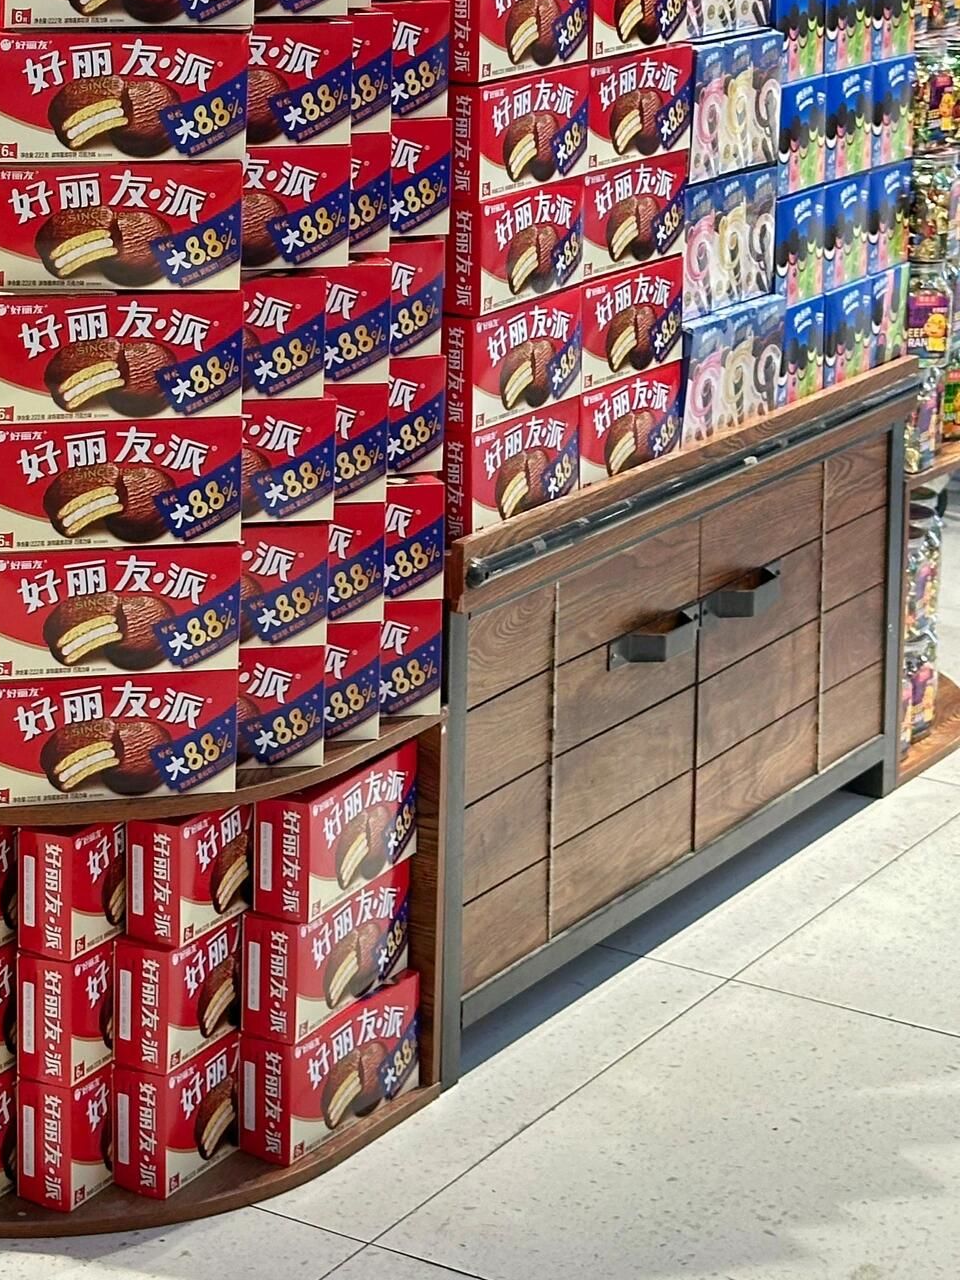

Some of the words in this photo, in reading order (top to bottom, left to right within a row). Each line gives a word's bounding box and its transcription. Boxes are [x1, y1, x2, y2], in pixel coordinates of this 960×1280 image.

[22, 38, 215, 95] 好丽友·派
[599, 57, 680, 111] 好丽友·派
[492, 77, 575, 136] 好丽友·派
[8, 170, 206, 224] 好丽友·派
[495, 189, 573, 250] 好丽友·派
[594, 164, 675, 217] 好丽友·派
[18, 300, 210, 358] 好丽友·派
[594, 273, 671, 331] 好丽友·派
[487, 305, 570, 367] 好丽友·派
[593, 380, 670, 437] 好丽友·派
[17, 426, 209, 484] 好丽友·派
[484, 416, 566, 480] 好丽友·派
[17, 555, 208, 613] 好丽友·派
[14, 680, 204, 741] 好丽友·派
[322, 770, 404, 849] 好丽友·派
[153, 834, 172, 937] 好丽友·派
[282, 811, 301, 912] 好丽友·派
[45, 843, 63, 949] 好丽友·派
[310, 885, 397, 971] 好丽友·派
[270, 932, 288, 1032] 好丽友·派
[307, 1005, 404, 1087] 好丽友·派
